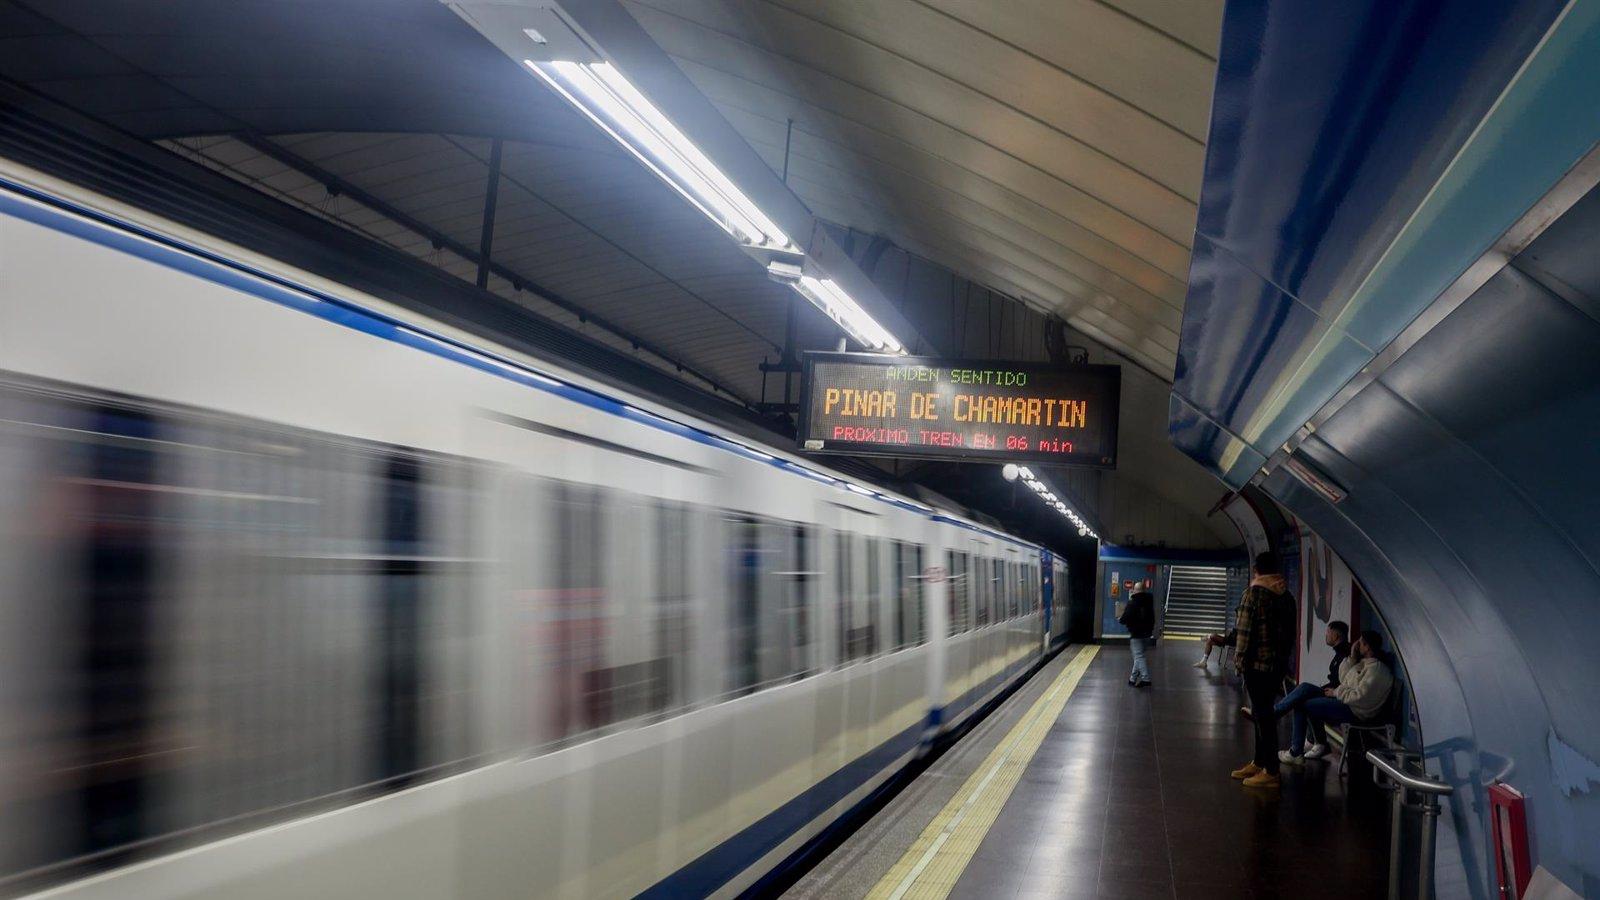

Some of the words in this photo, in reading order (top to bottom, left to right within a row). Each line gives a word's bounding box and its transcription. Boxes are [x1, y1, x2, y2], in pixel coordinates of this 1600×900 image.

[886, 366, 939, 382] ANDEN
[950, 369, 1028, 387] SENTIDO
[824, 388, 897, 418] PINAR
[910, 392, 940, 420] DE
[953, 394, 1088, 428] CHAMARTIN
[833, 426, 908, 445] PROXIMO
[920, 430, 963, 448] TREN
[973, 433, 996, 449] EN
[1006, 435, 1029, 450] 06
[1039, 436, 1073, 453] min
